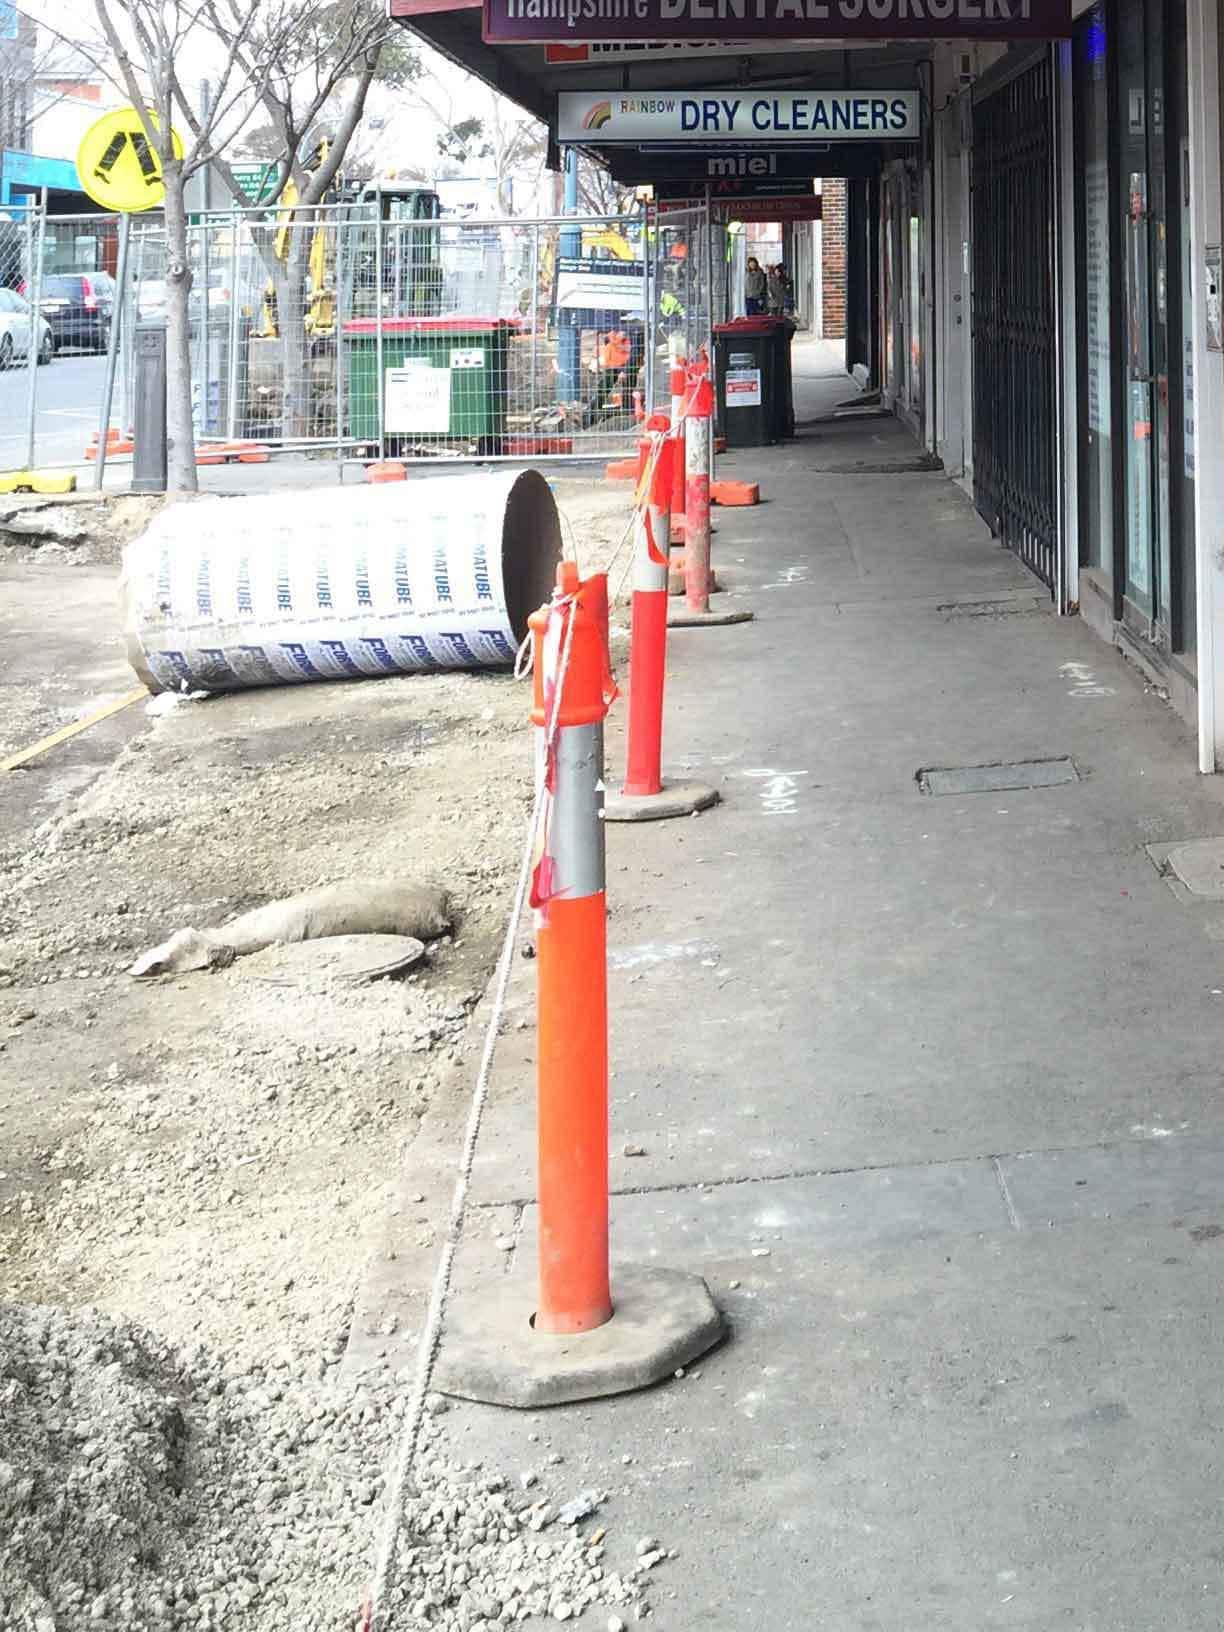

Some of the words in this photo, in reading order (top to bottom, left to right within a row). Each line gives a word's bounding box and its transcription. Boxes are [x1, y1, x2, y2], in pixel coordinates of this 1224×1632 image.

[619, 101, 675, 112] RAINBOW
[681, 100, 741, 131] DRY
[751, 99, 908, 131] CLEANERS
[707, 153, 777, 175] miel
